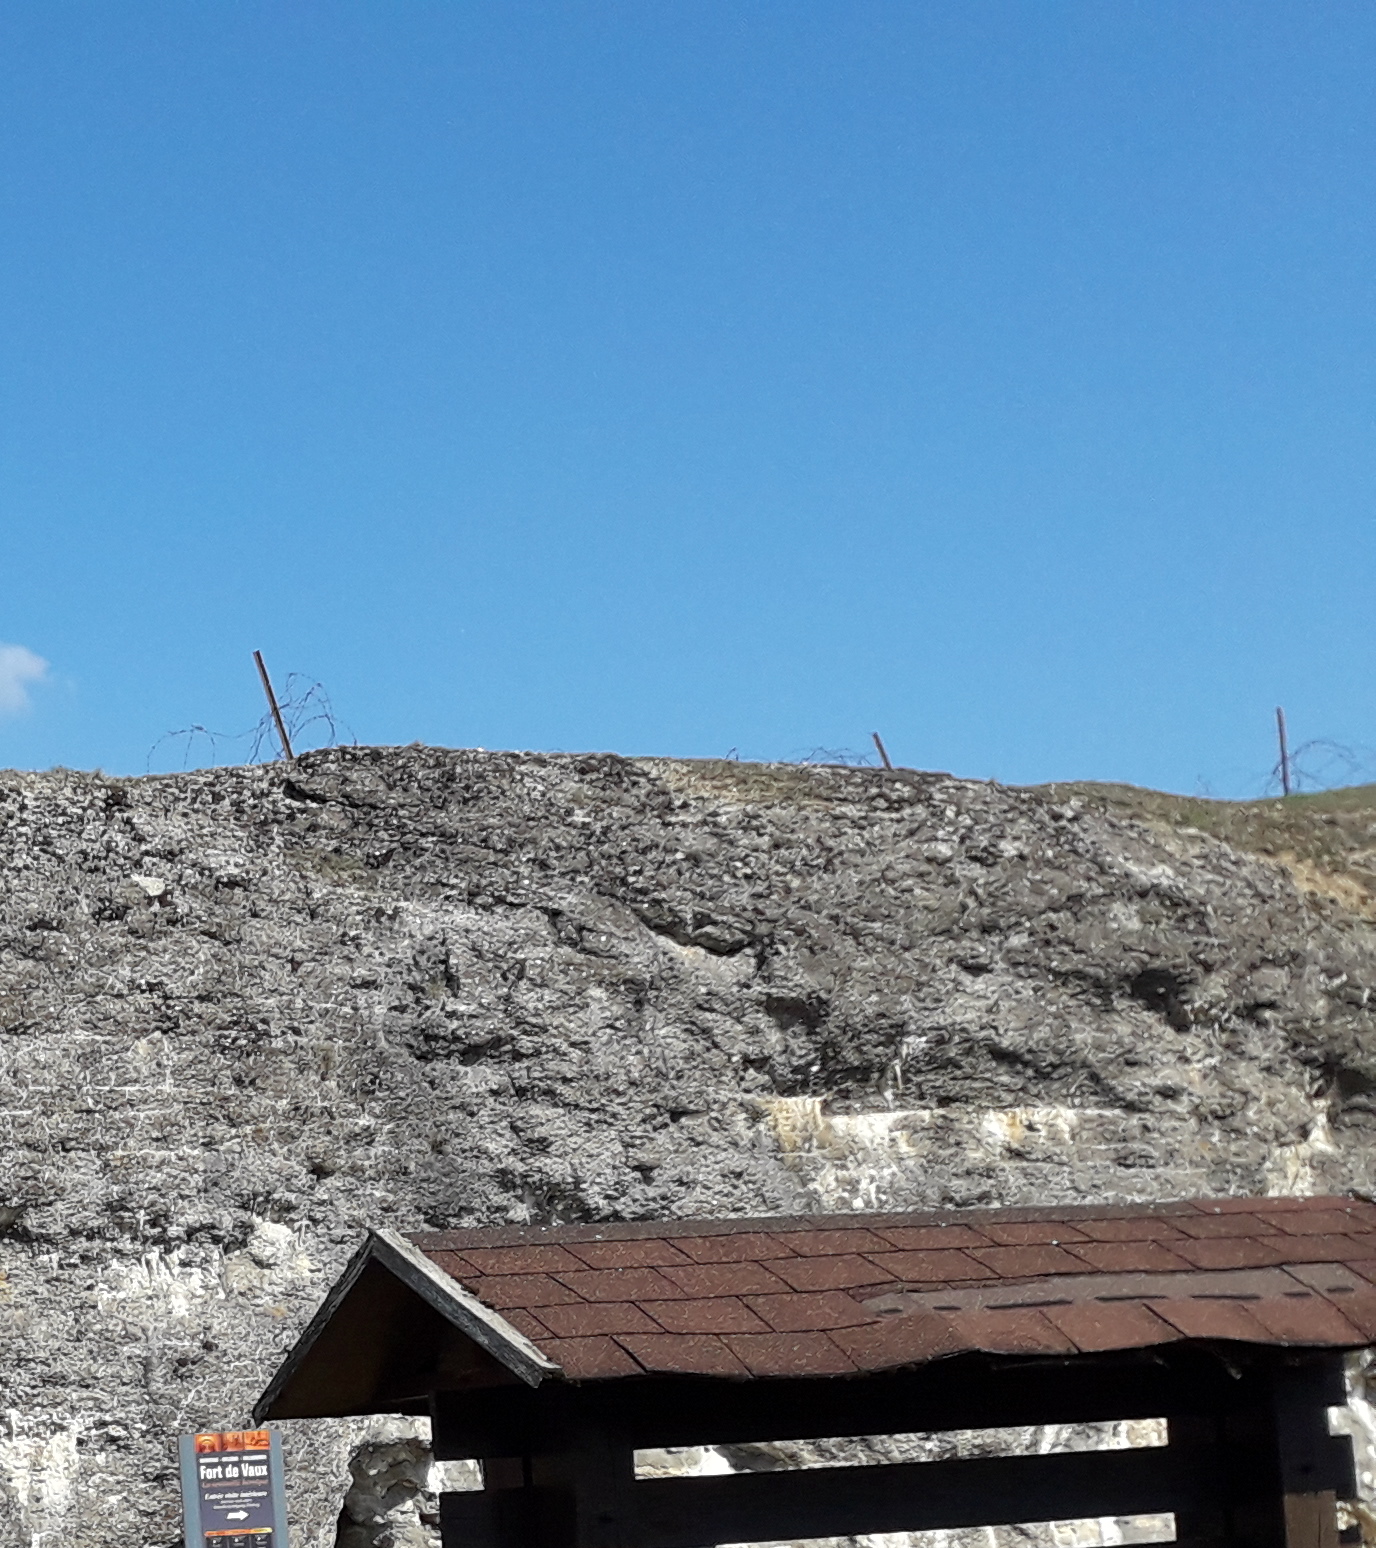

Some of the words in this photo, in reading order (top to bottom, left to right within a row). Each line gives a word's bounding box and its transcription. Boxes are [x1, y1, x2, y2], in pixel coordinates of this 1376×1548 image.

[200, 1465, 223, 1479] Fort
[226, 1464, 239, 1478] de
[241, 1463, 268, 1477] Vaux
